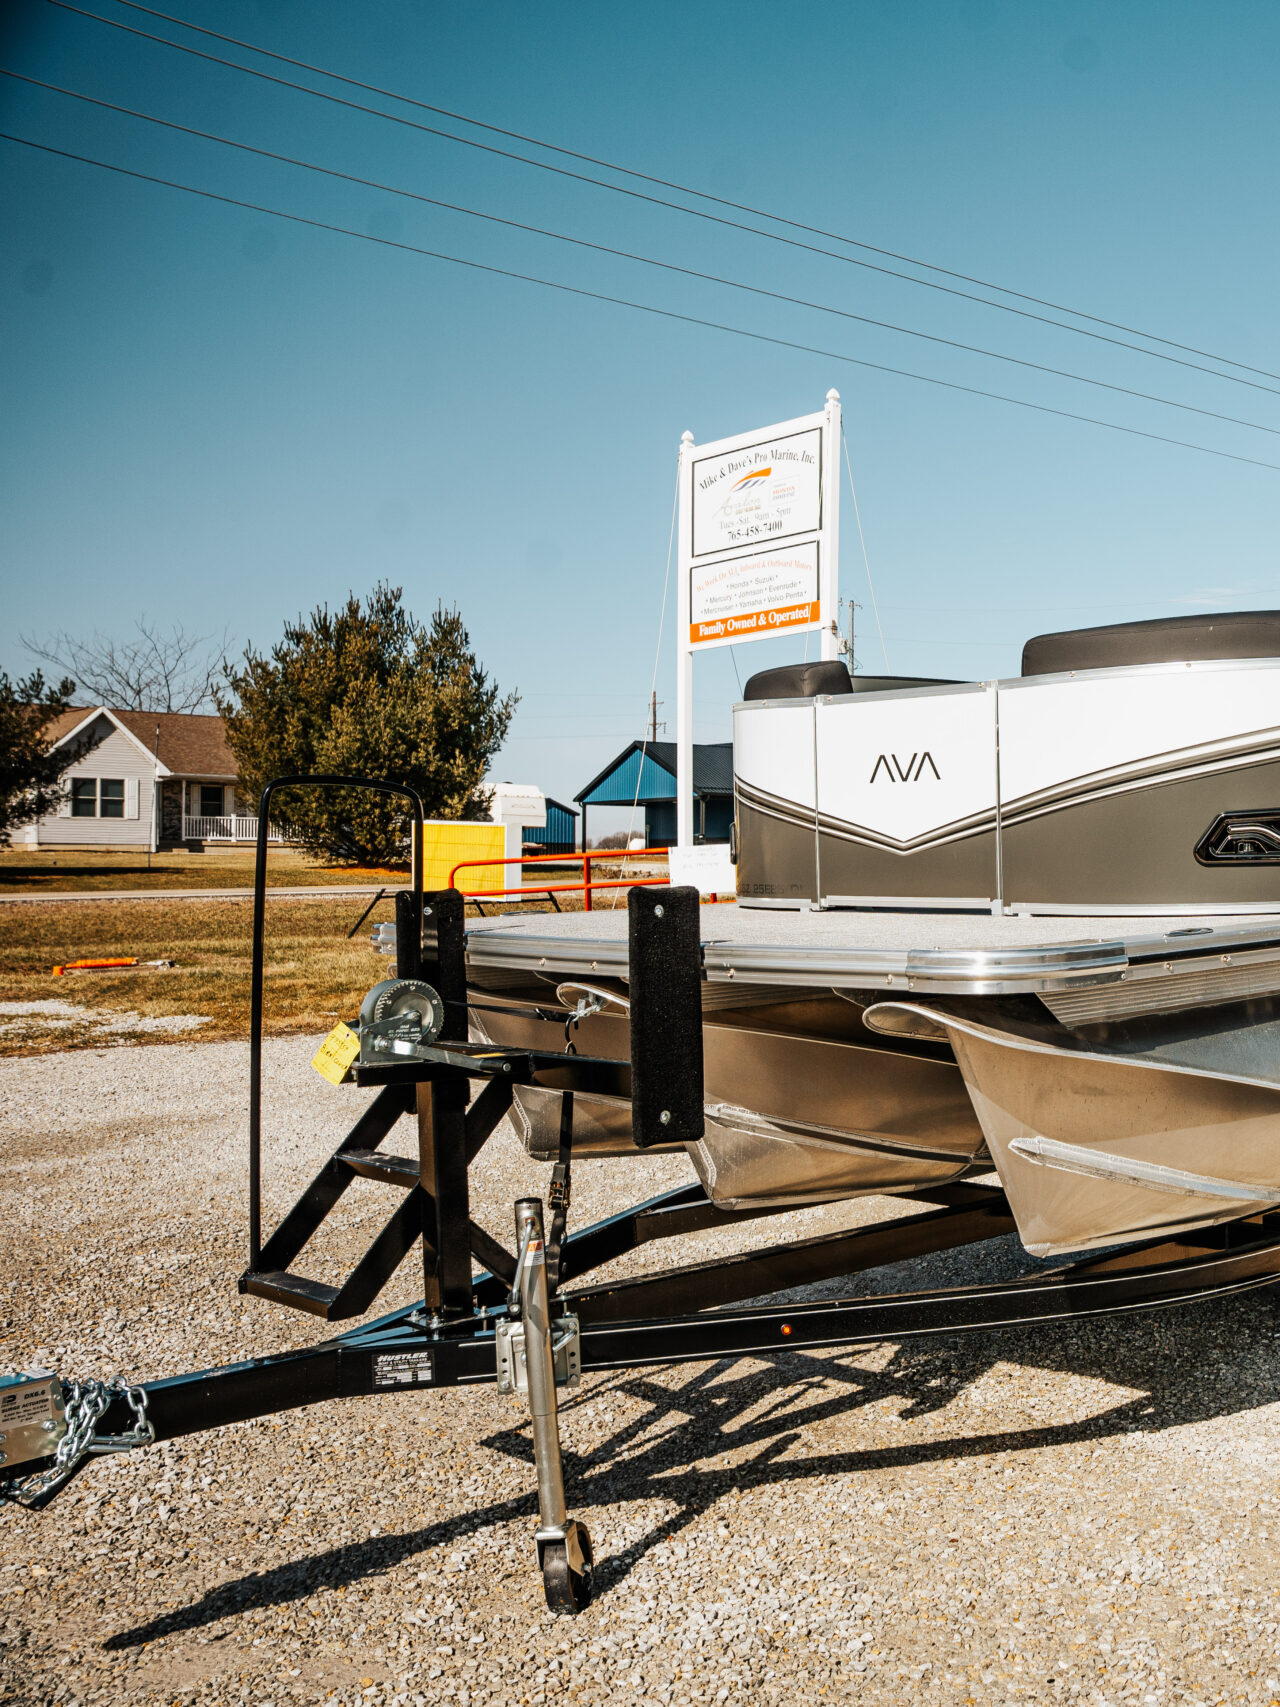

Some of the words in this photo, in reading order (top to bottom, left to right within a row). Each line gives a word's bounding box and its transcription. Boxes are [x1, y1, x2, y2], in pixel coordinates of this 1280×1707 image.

[699, 474, 718, 490] Mike
[719, 468, 726, 478] &
[728, 456, 752, 473] Dave's
[754, 452, 768, 464] Pro
[801, 450, 816, 464] Inc.
[727, 520, 783, 542] 765-458-7400
[730, 581, 749, 589] Honda
[754, 576, 775, 585] Suzuki
[709, 595, 732, 604] Mercury
[738, 589, 764, 599] Johnson
[739, 599, 762, 608] Yamaha
[767, 594, 784, 603] Volvo
[785, 592, 804, 600] Penta
[699, 622, 726, 636] Family
[726, 615, 756, 627] Owned
[758, 615, 767, 626] &
[768, 605, 809, 626] Operated
[869, 751, 941, 784] AVA
[377, 1351, 429, 1362] HUSTLER
[24, 1389, 46, 1400] DX6.6
[22, 1398, 49, 1408] ACTUATOR
